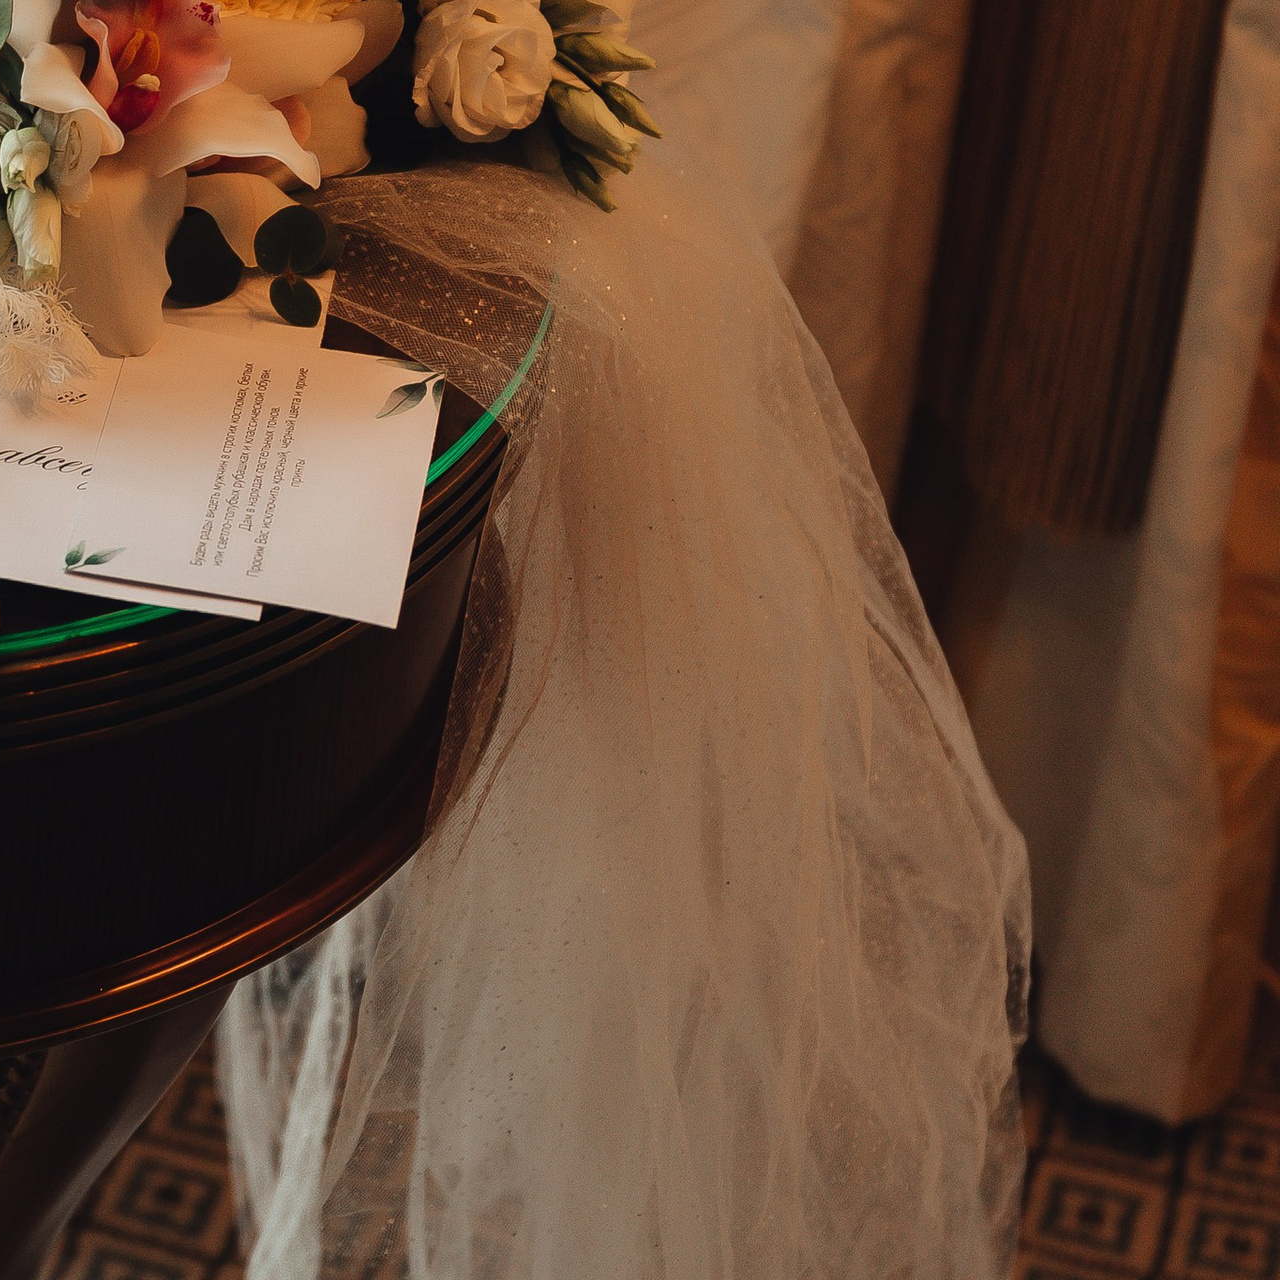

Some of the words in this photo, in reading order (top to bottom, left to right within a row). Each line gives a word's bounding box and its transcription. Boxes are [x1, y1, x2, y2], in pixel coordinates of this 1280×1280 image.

[237, 362, 254, 386] белых
[295, 367, 309, 391] яркие
[289, 397, 302, 420] цвета
[222, 424, 238, 454] строгих
[213, 460, 228, 491] мужчин
[213, 551, 224, 567] или
[232, 452, 250, 488] рубашках
[245, 391, 265, 444] классической
[238, 515, 253, 532] Дам
[248, 475, 263, 507] нарядах
[256, 430, 275, 474] пастельных
[290, 458, 306, 488] принты
[206, 492, 221, 519] видеть
[262, 486, 280, 529] исключить
[200, 519, 213, 541] рады
[254, 530, 269, 545] Вас
[189, 541, 207, 567] Будем
[246, 545, 264, 578] Просим
